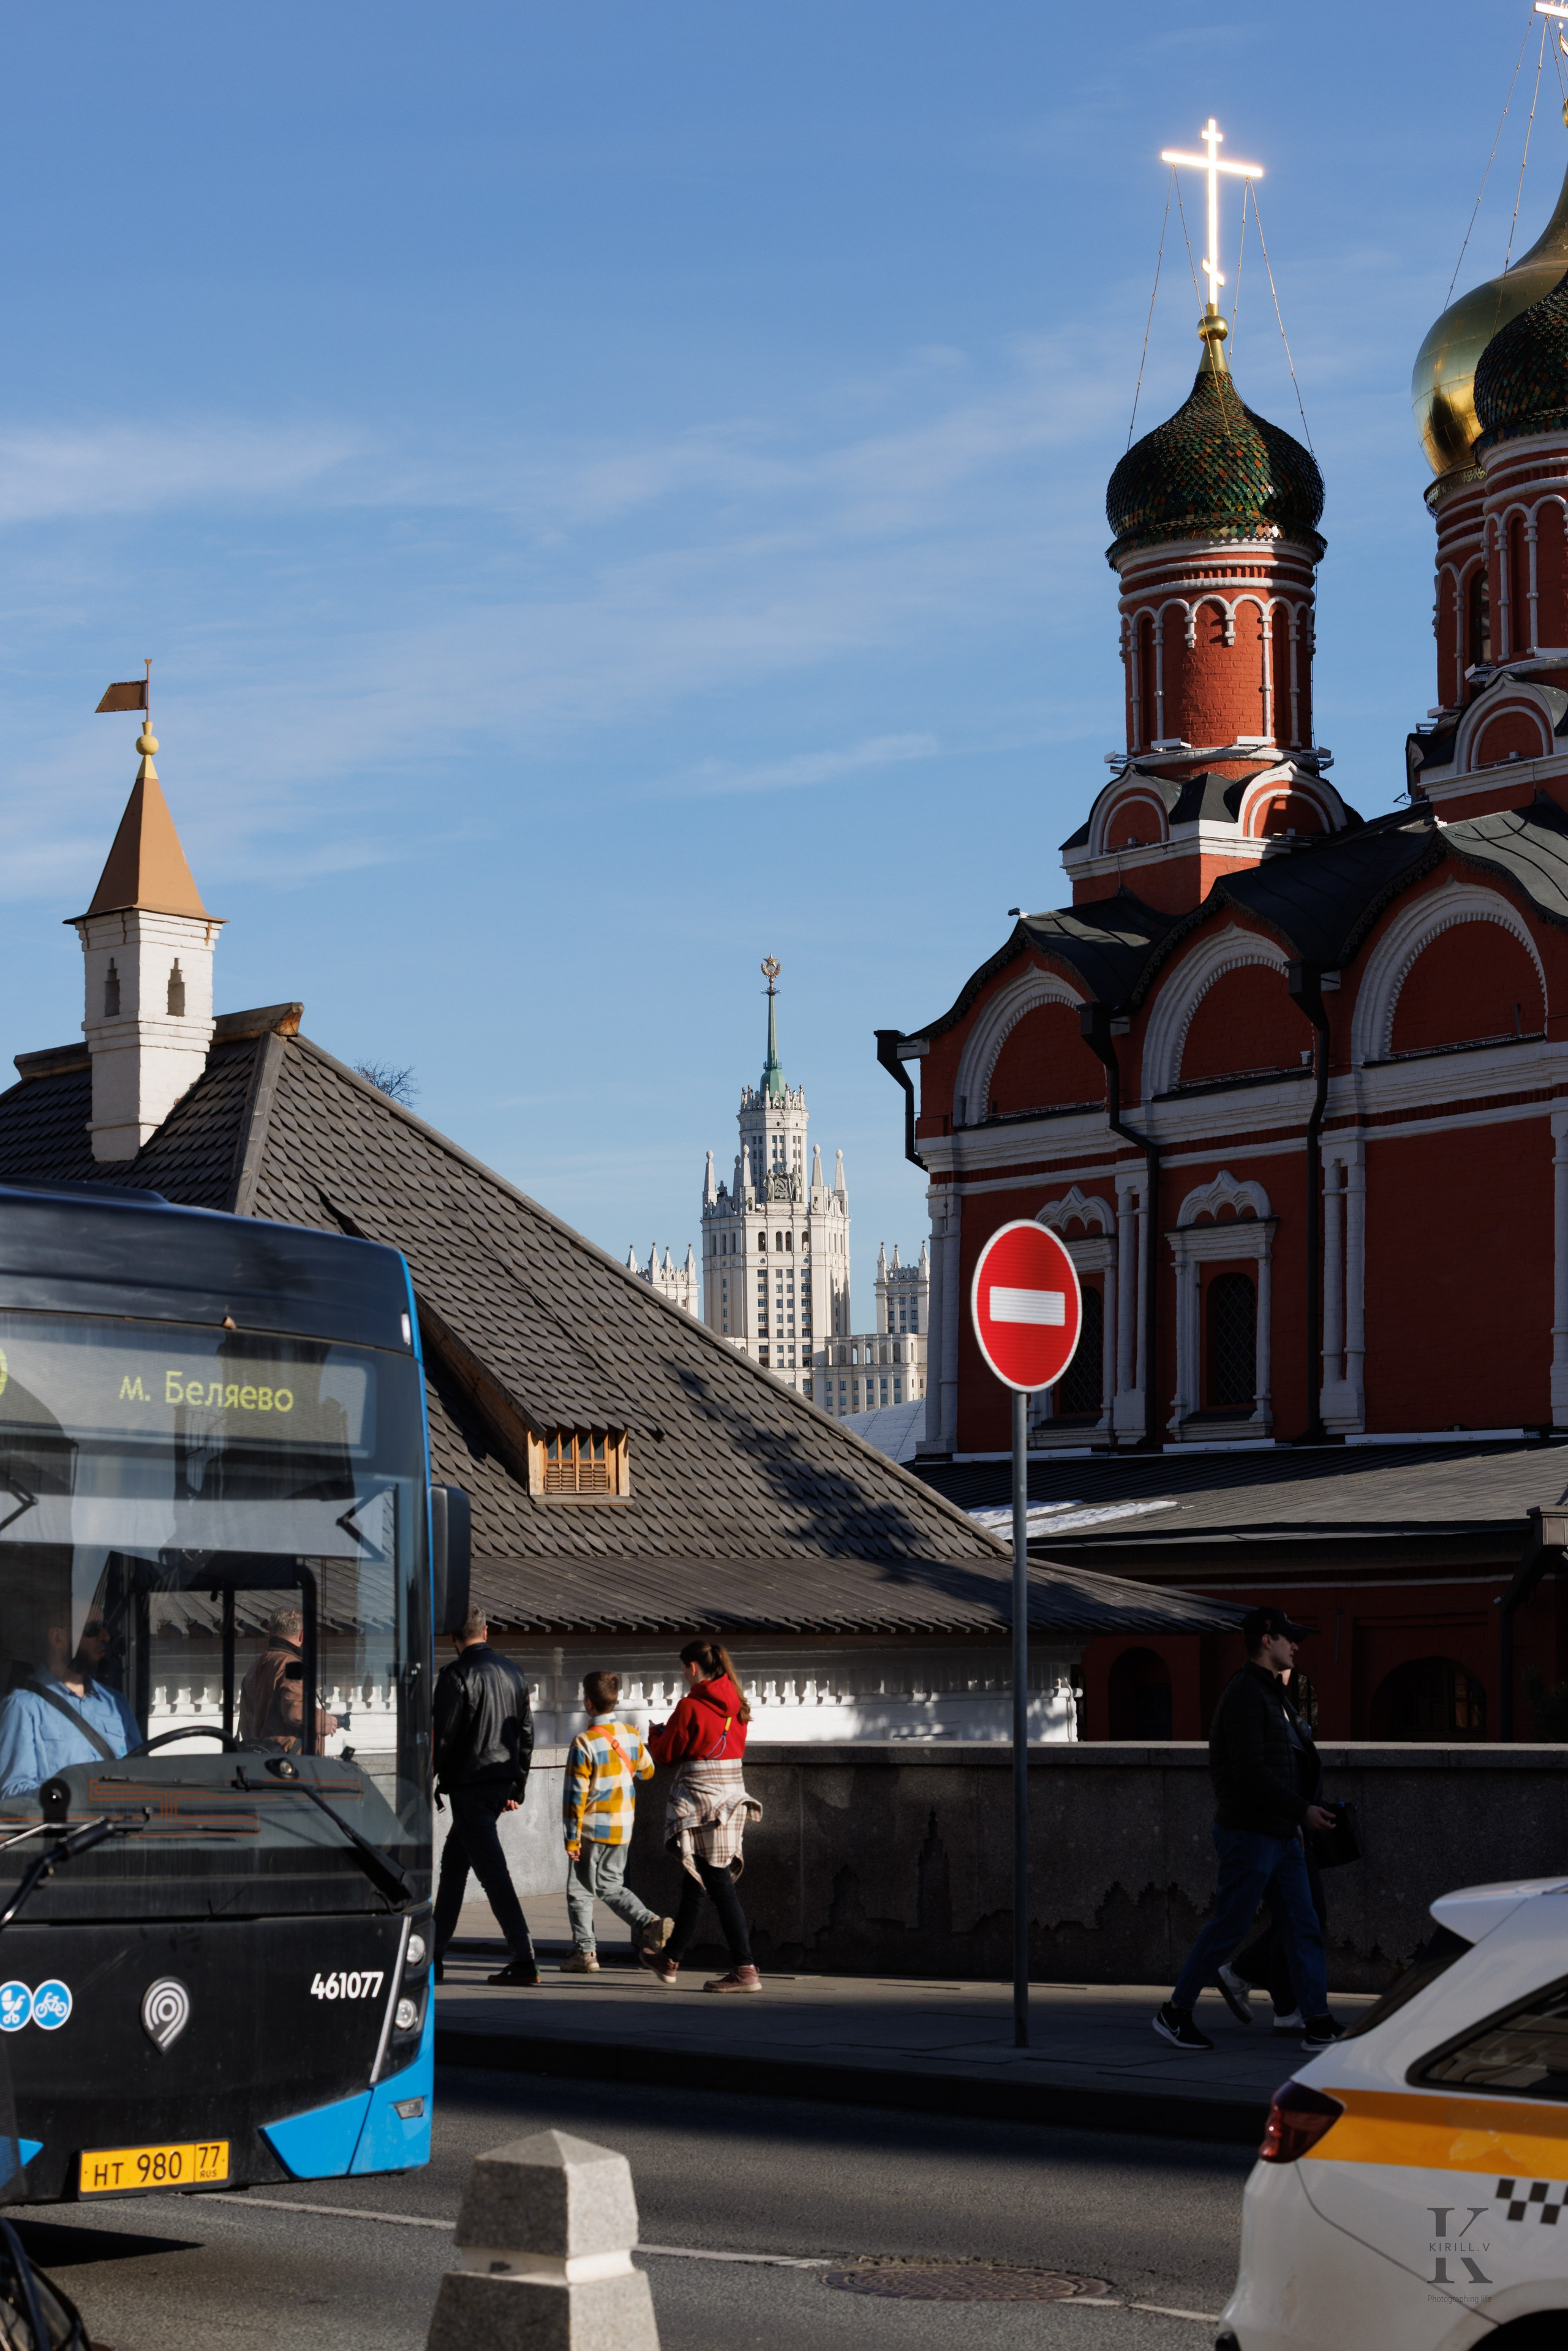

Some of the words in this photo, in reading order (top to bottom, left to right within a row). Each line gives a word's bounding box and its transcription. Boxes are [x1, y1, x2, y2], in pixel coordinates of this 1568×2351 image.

[165, 1370, 294, 1412] Беляево
[311, 1971, 384, 1999] 461077
[137, 2151, 182, 2183] 980
[198, 2146, 220, 2168] 77
[200, 2169, 217, 2178] RUS
